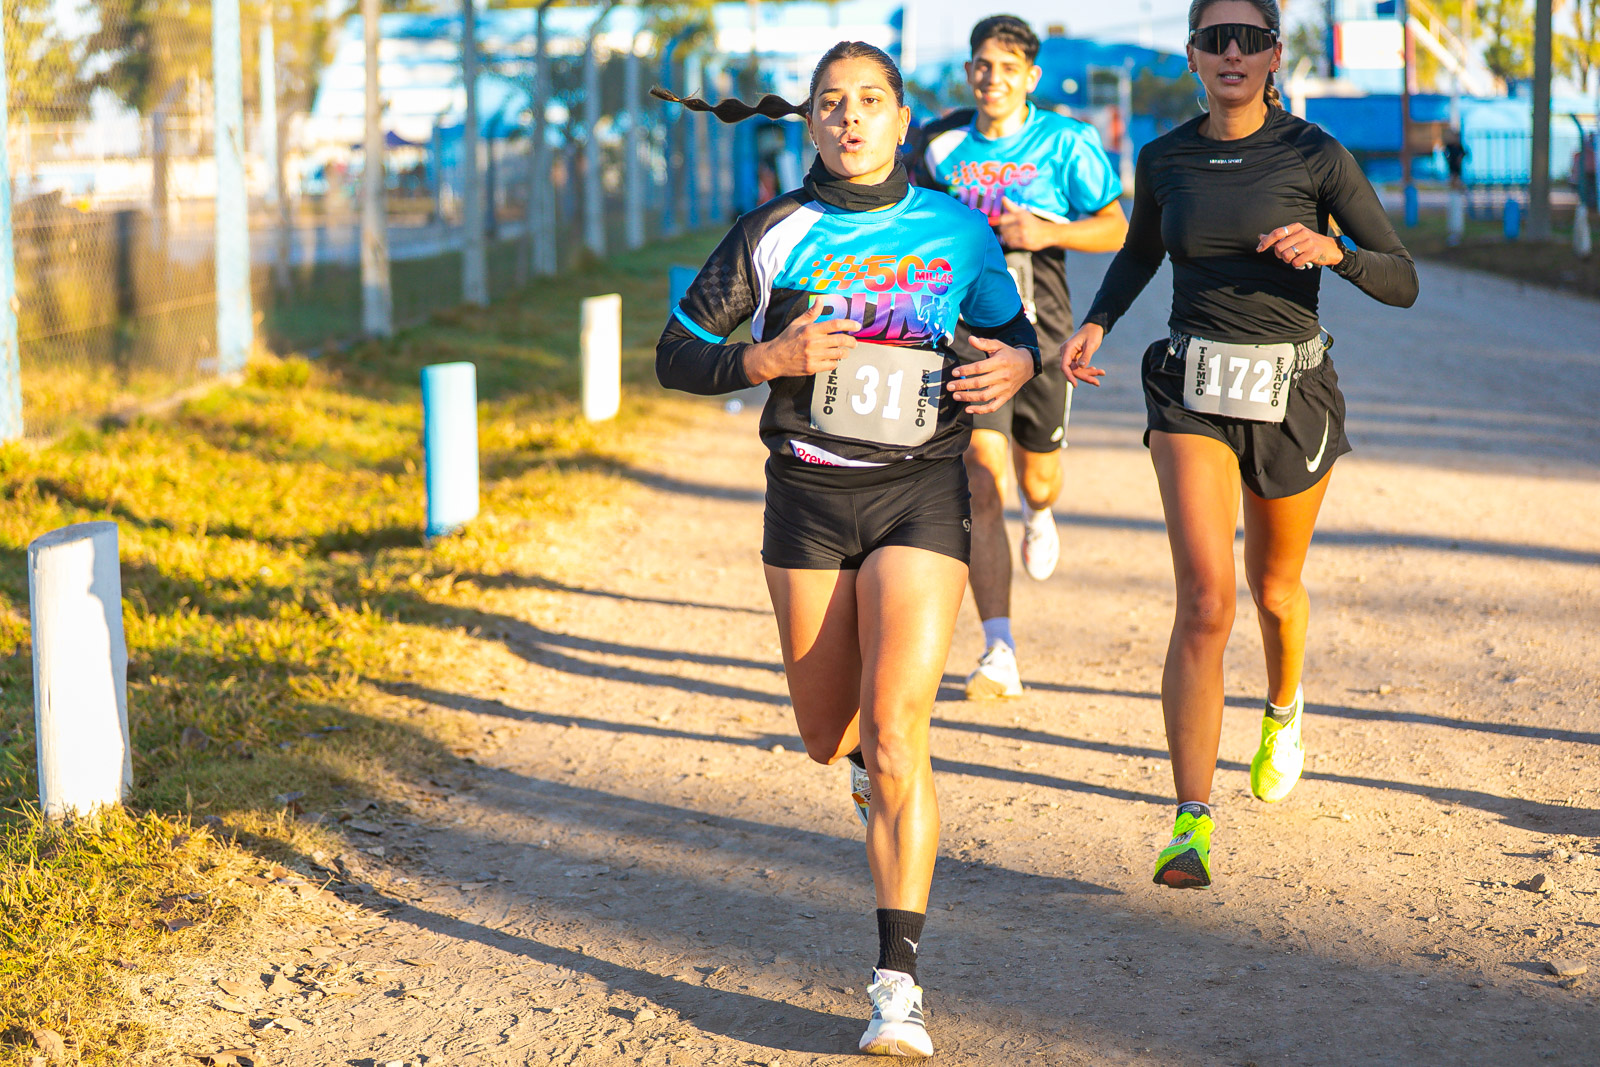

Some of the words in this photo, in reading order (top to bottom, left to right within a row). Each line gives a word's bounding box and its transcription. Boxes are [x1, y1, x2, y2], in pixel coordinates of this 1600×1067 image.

[862, 254, 953, 296] 500
[914, 271, 954, 285] MILLAS
[823, 358, 841, 415] IEMPO
[851, 364, 904, 420] 31
[1195, 346, 1208, 396] TIEMPO
[1206, 353, 1273, 404] 172
[1270, 356, 1284, 407] EXACTO
[915, 369, 931, 427] EXACTO
